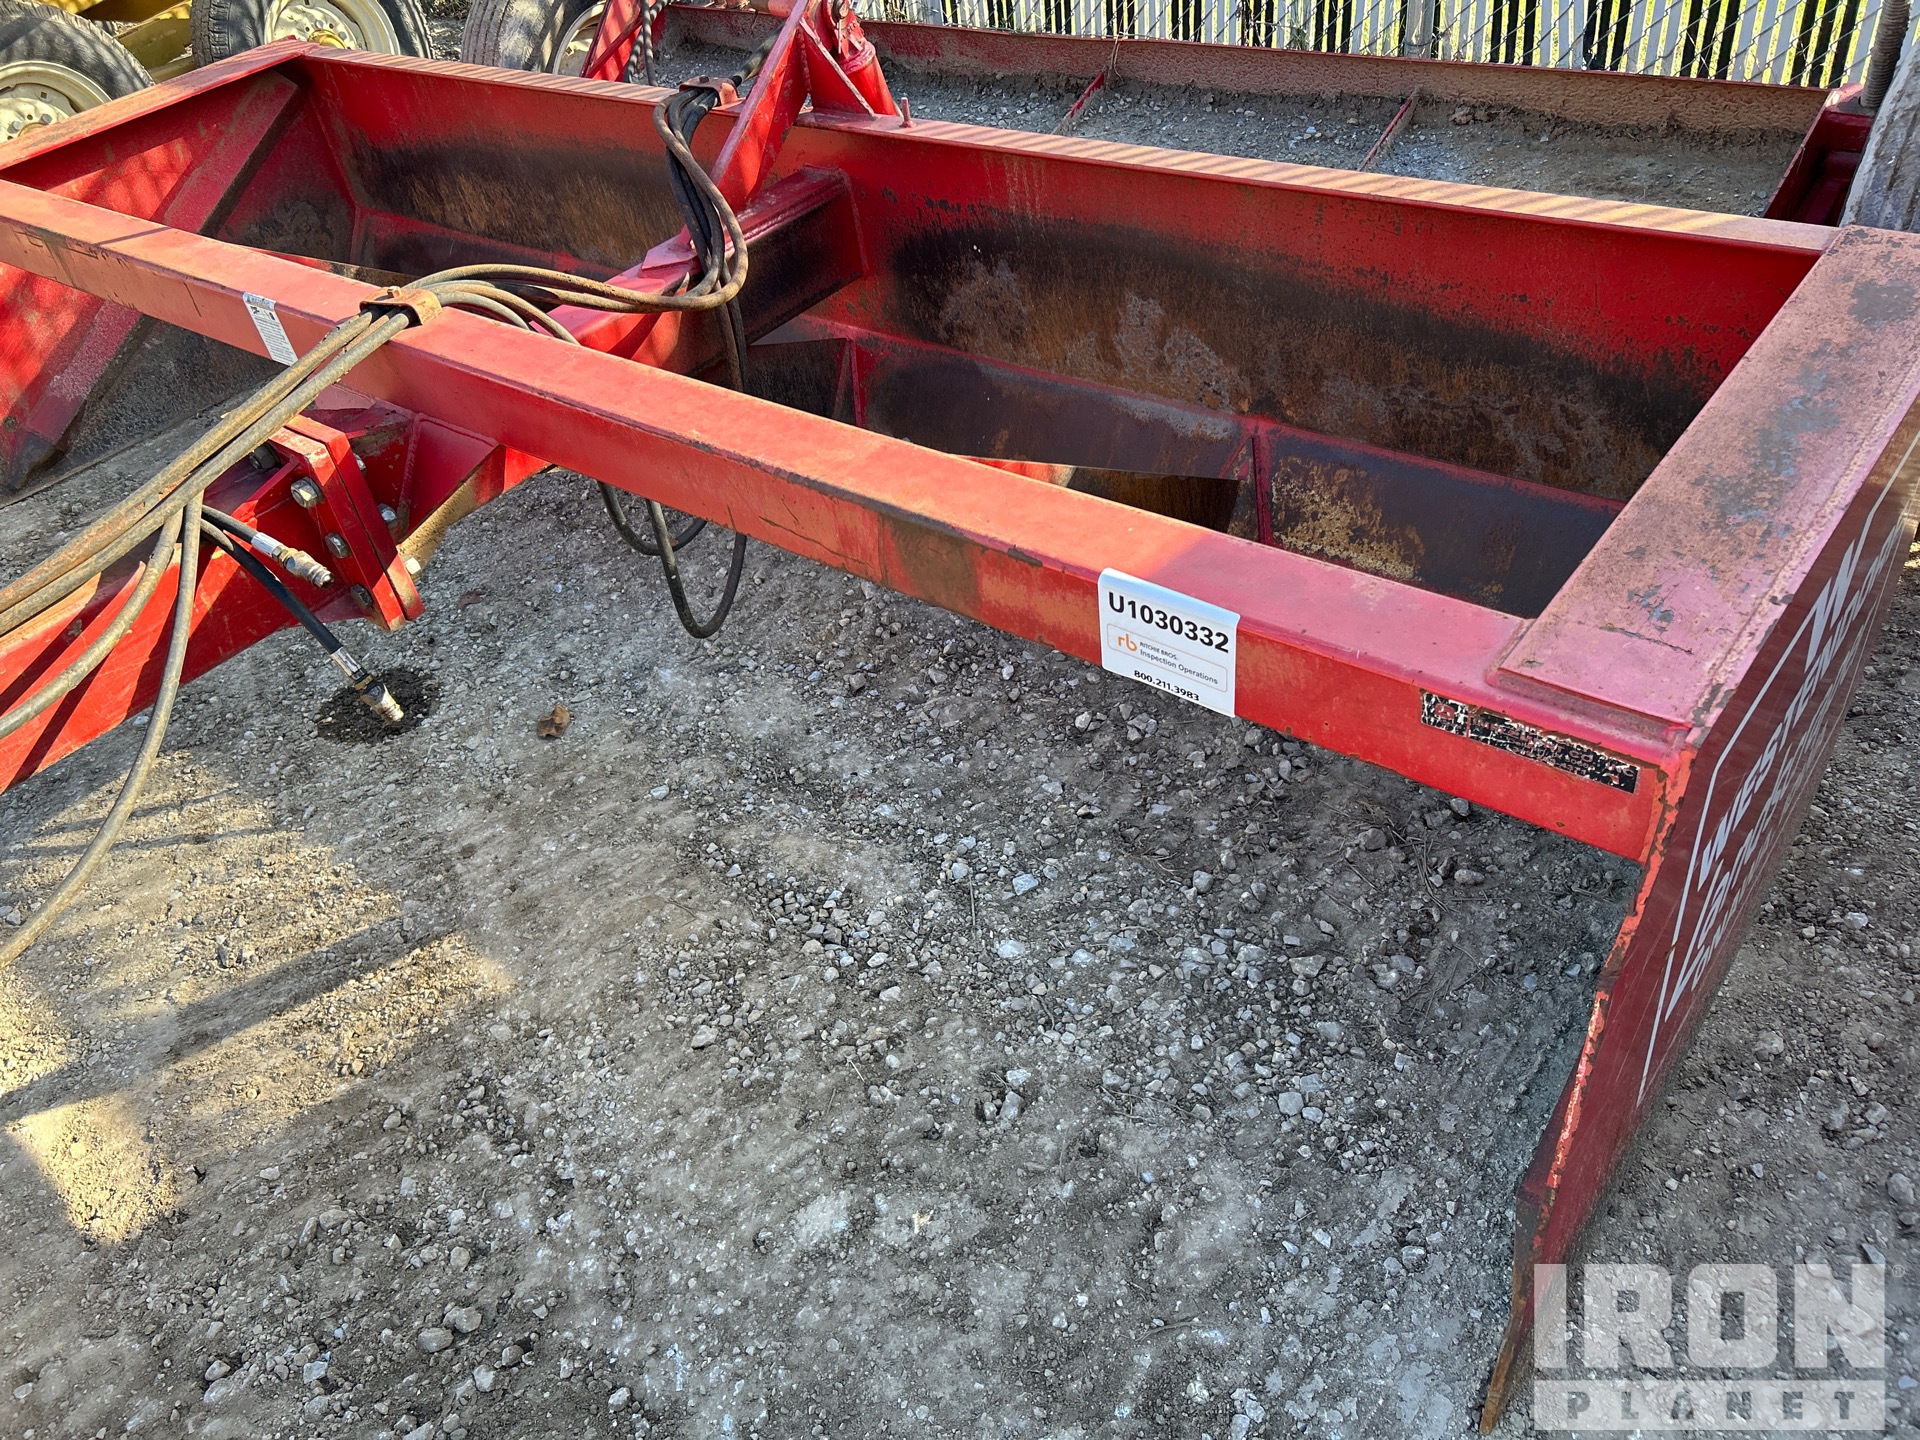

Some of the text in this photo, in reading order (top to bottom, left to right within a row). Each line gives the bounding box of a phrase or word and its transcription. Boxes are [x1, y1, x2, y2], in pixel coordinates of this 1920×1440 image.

[1108, 591, 1229, 653] U1030332
[1117, 633, 1137, 652] rb
[1139, 641, 1160, 654] RITCHIE
[1140, 649, 1218, 685] Inspection Operations
[1134, 669, 1200, 701] 800.211.3983
